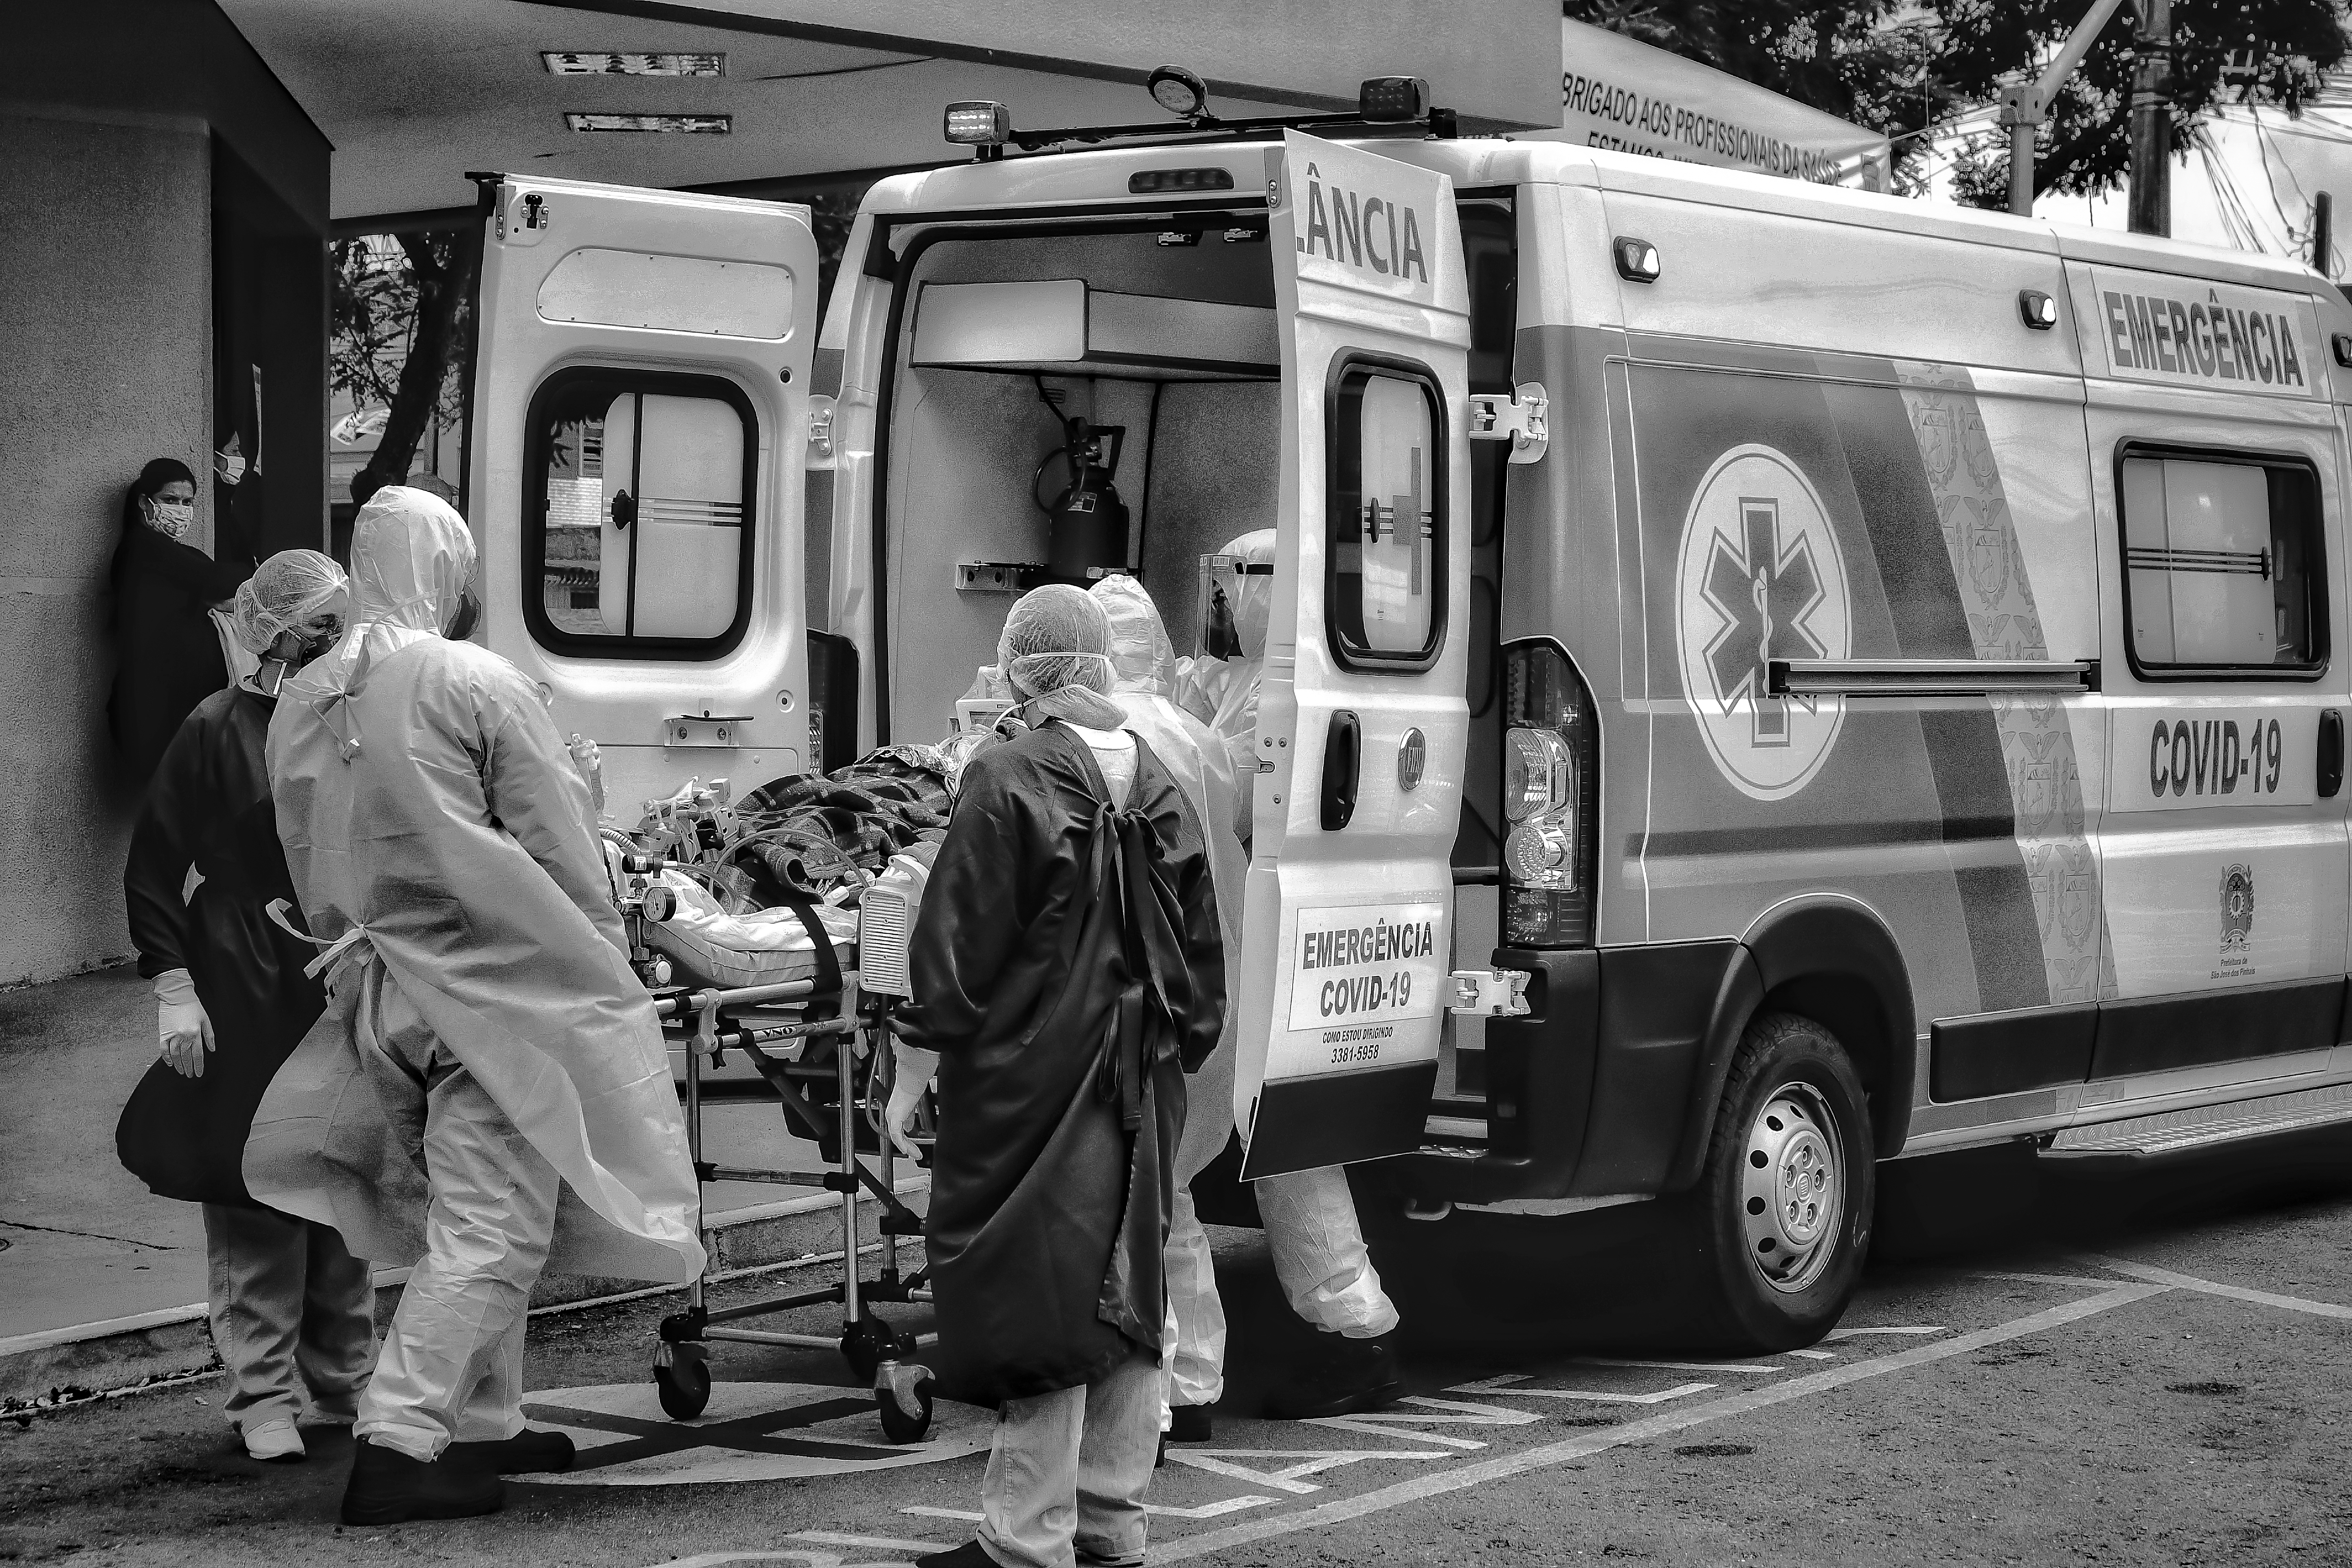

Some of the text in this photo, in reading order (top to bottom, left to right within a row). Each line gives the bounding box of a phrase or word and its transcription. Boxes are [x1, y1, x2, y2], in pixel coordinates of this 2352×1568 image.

[1639, 98, 1671, 136] AOS
[1676, 108, 1779, 171] PROFISSIONAIS
[1784, 144, 1799, 178] DA
[1297, 162, 1427, 283] ÂNCIA
[2104, 288, 2304, 386] EMERGÊNCIA
[2151, 719, 2281, 797] COVID-19
[1303, 918, 1432, 970] EMERGÊNCIA
[1320, 971, 1411, 1017] COVID-19
[1322, 1026, 1393, 1044] COMO ESTOU DIRIGINDO
[1331, 1044, 1379, 1063] 3381-5958
